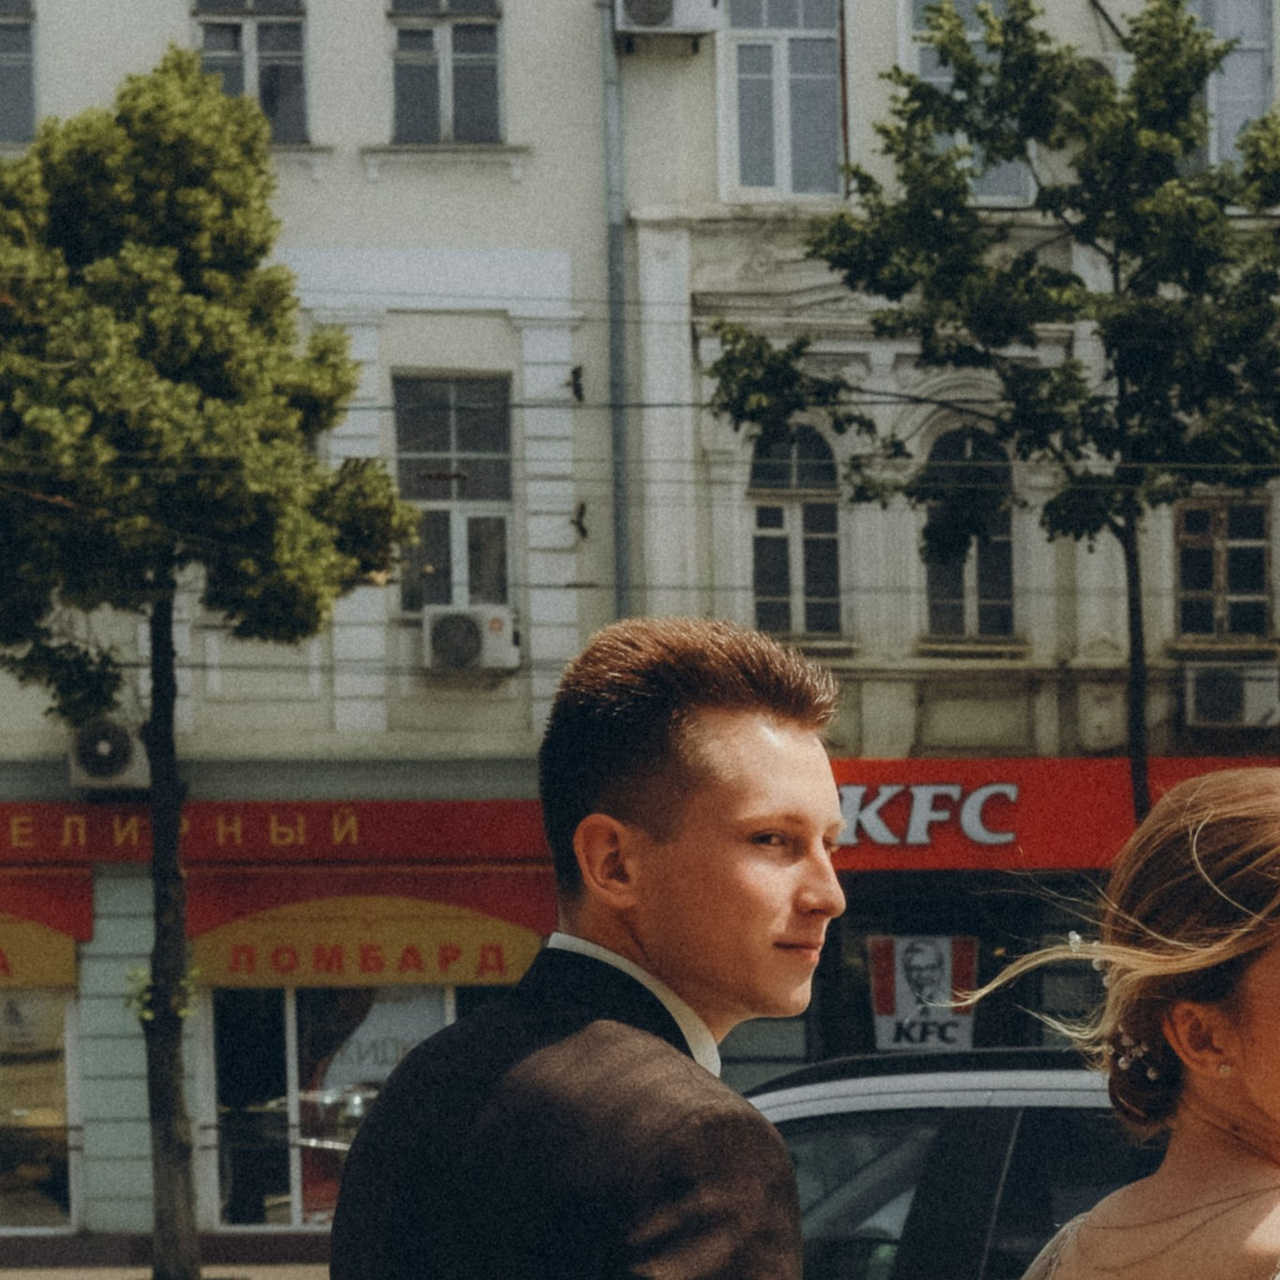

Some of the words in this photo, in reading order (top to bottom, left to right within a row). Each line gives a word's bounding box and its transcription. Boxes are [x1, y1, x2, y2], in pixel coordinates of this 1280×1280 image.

[10, 806, 359, 847] ЕЛИНЫЙ
[837, 784, 1018, 845] KFC
[228, 944, 507, 978] ЛОМБАРД
[893, 1020, 960, 1044] KFC
